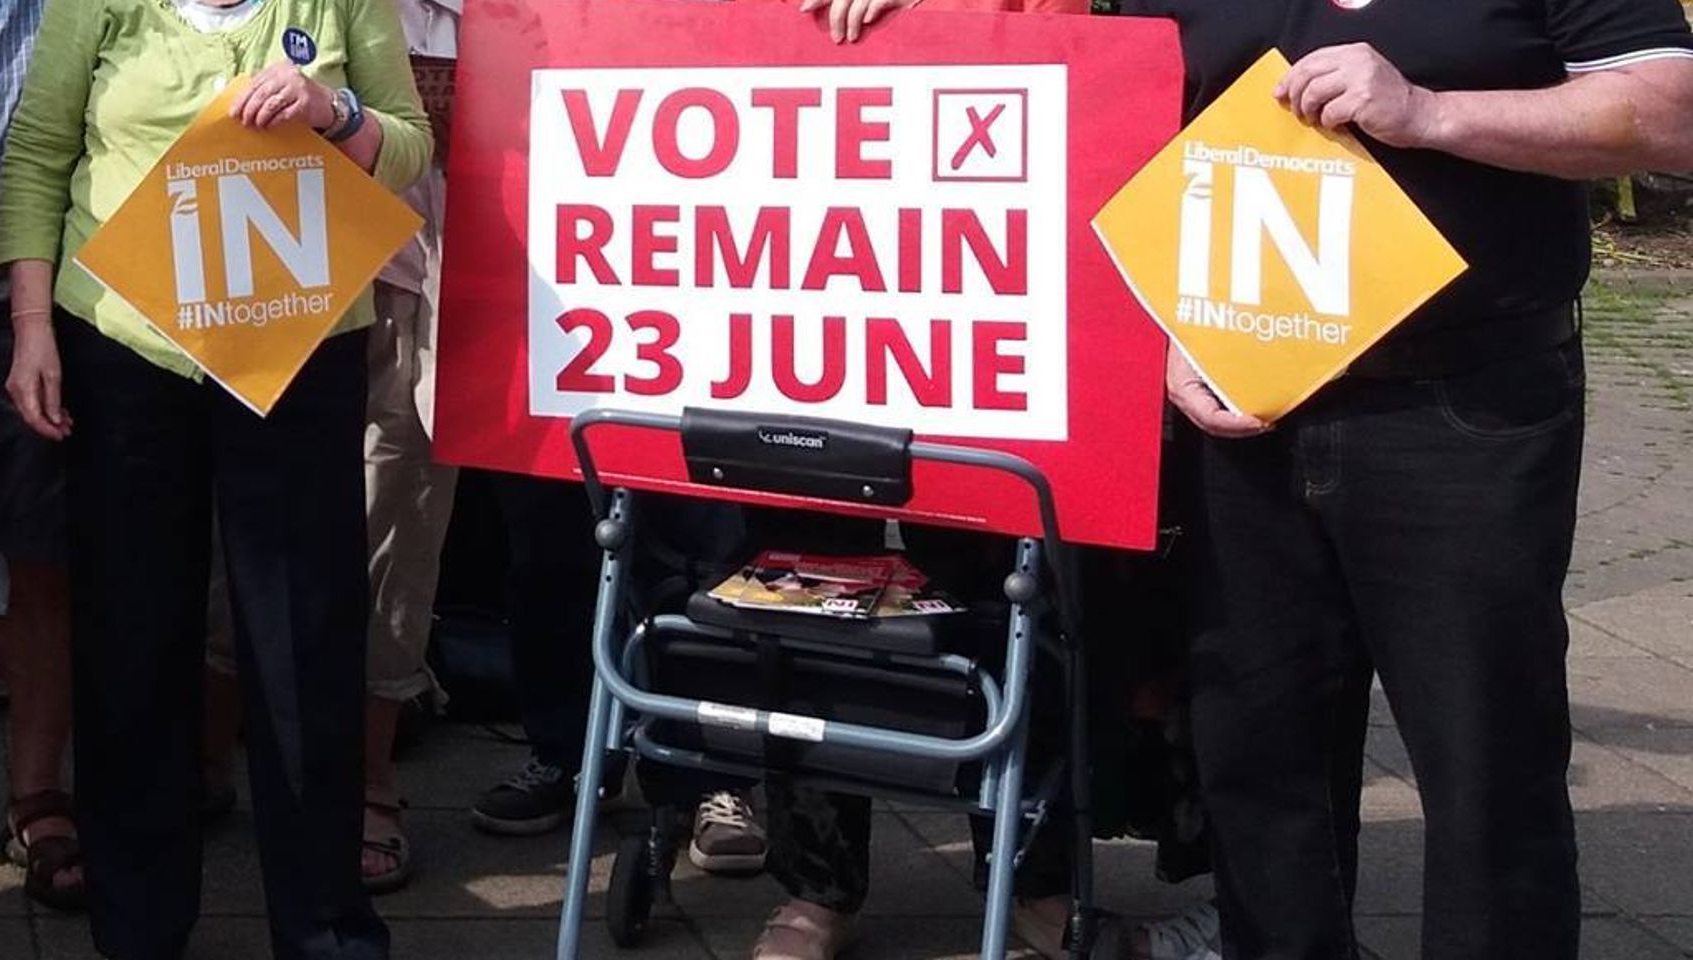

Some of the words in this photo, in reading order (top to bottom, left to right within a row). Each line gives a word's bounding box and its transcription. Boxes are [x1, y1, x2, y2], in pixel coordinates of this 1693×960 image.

[560, 86, 894, 180] VOTE
[555, 203, 1028, 296] REMAIN
[176, 291, 334, 331] #INtogether
[1176, 296, 1353, 344] #INtogether
[555, 309, 684, 396] 23
[710, 314, 1028, 412] JUNE
[772, 432, 823, 448] uniscan
